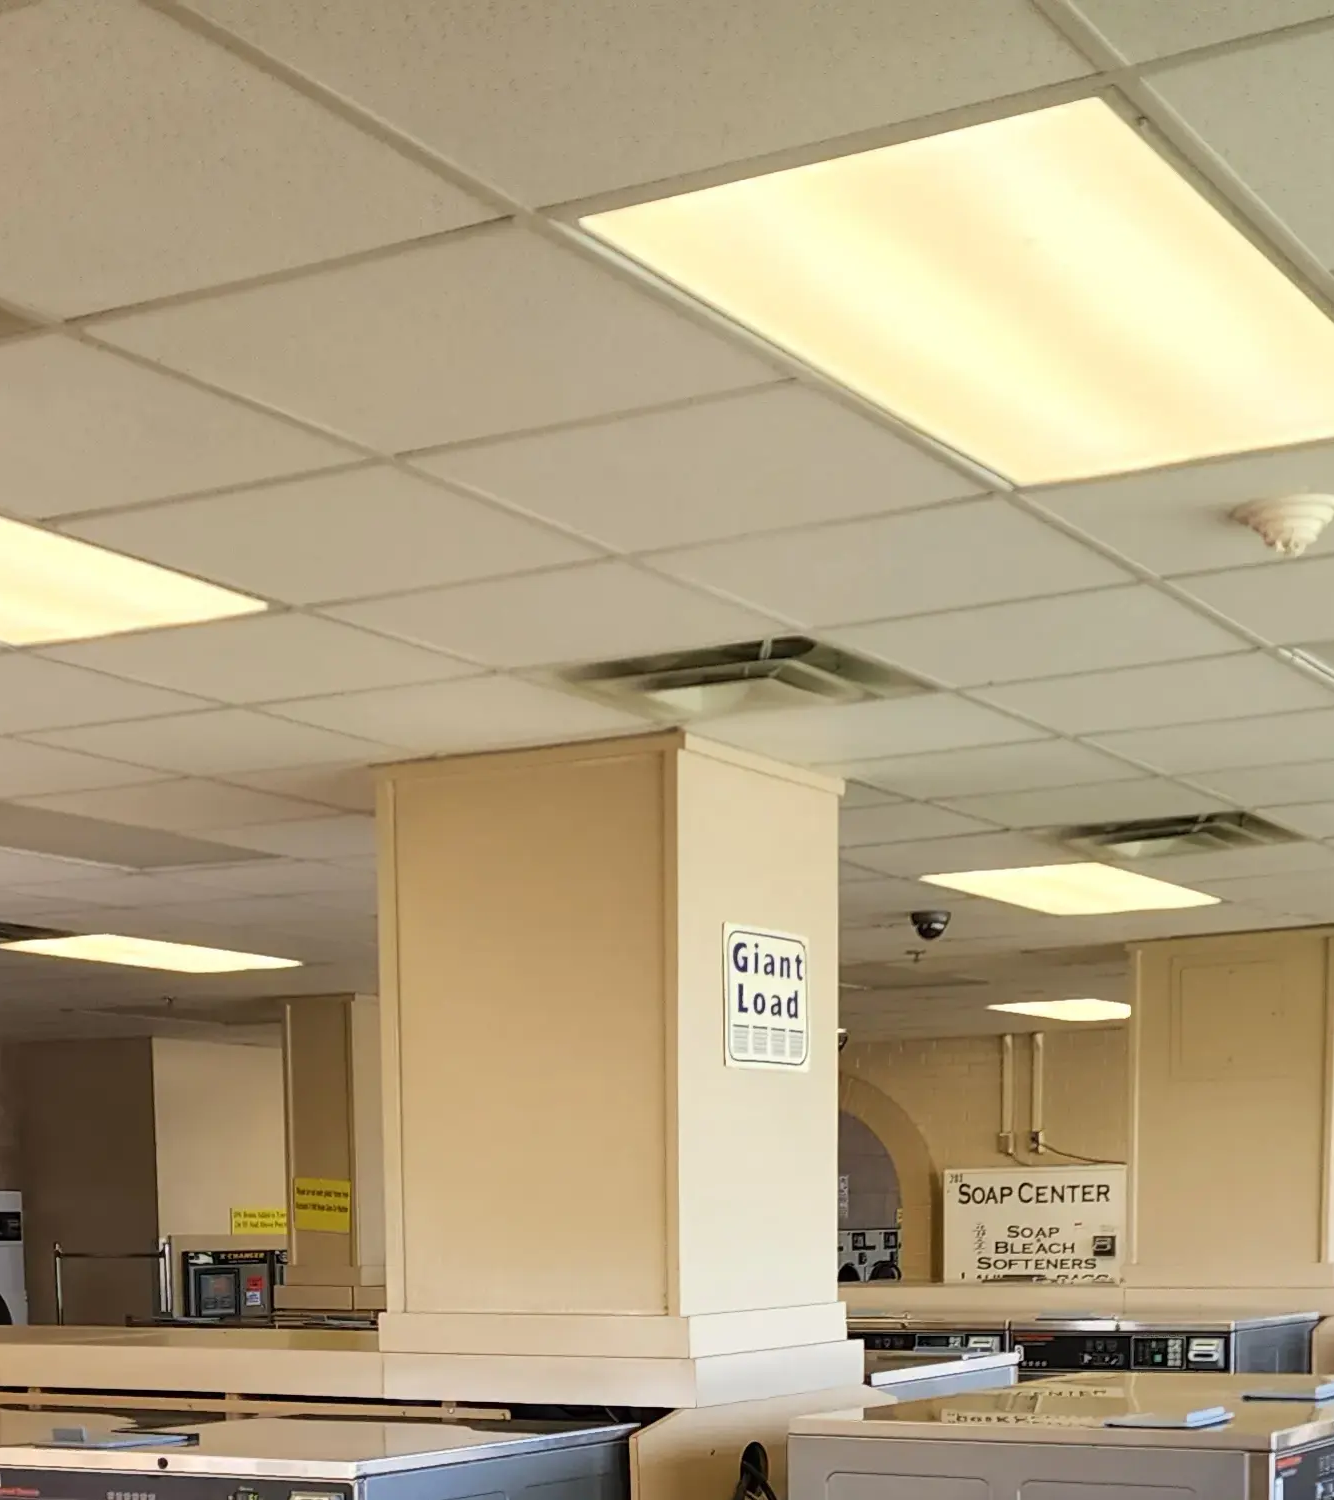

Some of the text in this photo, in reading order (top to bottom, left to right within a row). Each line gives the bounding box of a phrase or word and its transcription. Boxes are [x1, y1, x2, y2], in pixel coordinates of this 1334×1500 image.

[732, 942, 804, 981] Giant
[737, 983, 799, 1019] Load
[958, 1182, 1110, 1204] SOAP CENTER
[1007, 1225, 1060, 1239] SOAP
[994, 1241, 1075, 1254] BLEACH
[977, 1257, 1097, 1270] SOFTENERS
